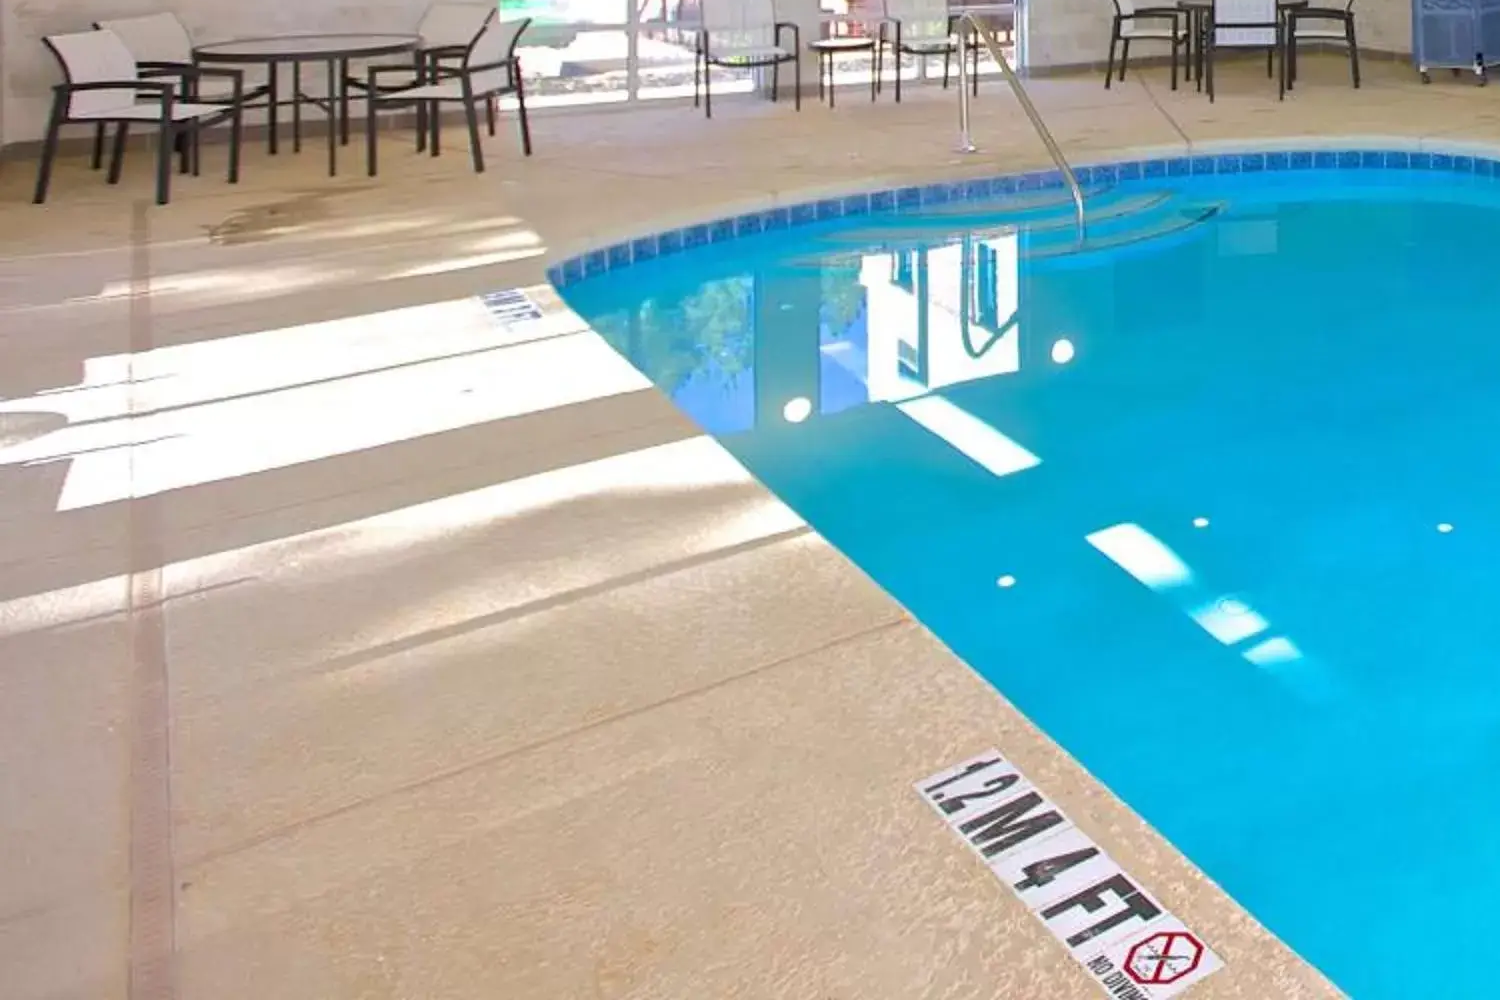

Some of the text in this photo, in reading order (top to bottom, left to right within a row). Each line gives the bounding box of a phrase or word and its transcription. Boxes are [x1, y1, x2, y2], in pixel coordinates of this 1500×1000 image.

[957, 789, 1065, 860] M
[1012, 845, 1102, 893] 4
[1039, 872, 1163, 950] FT
[1087, 954, 1115, 977] NO
